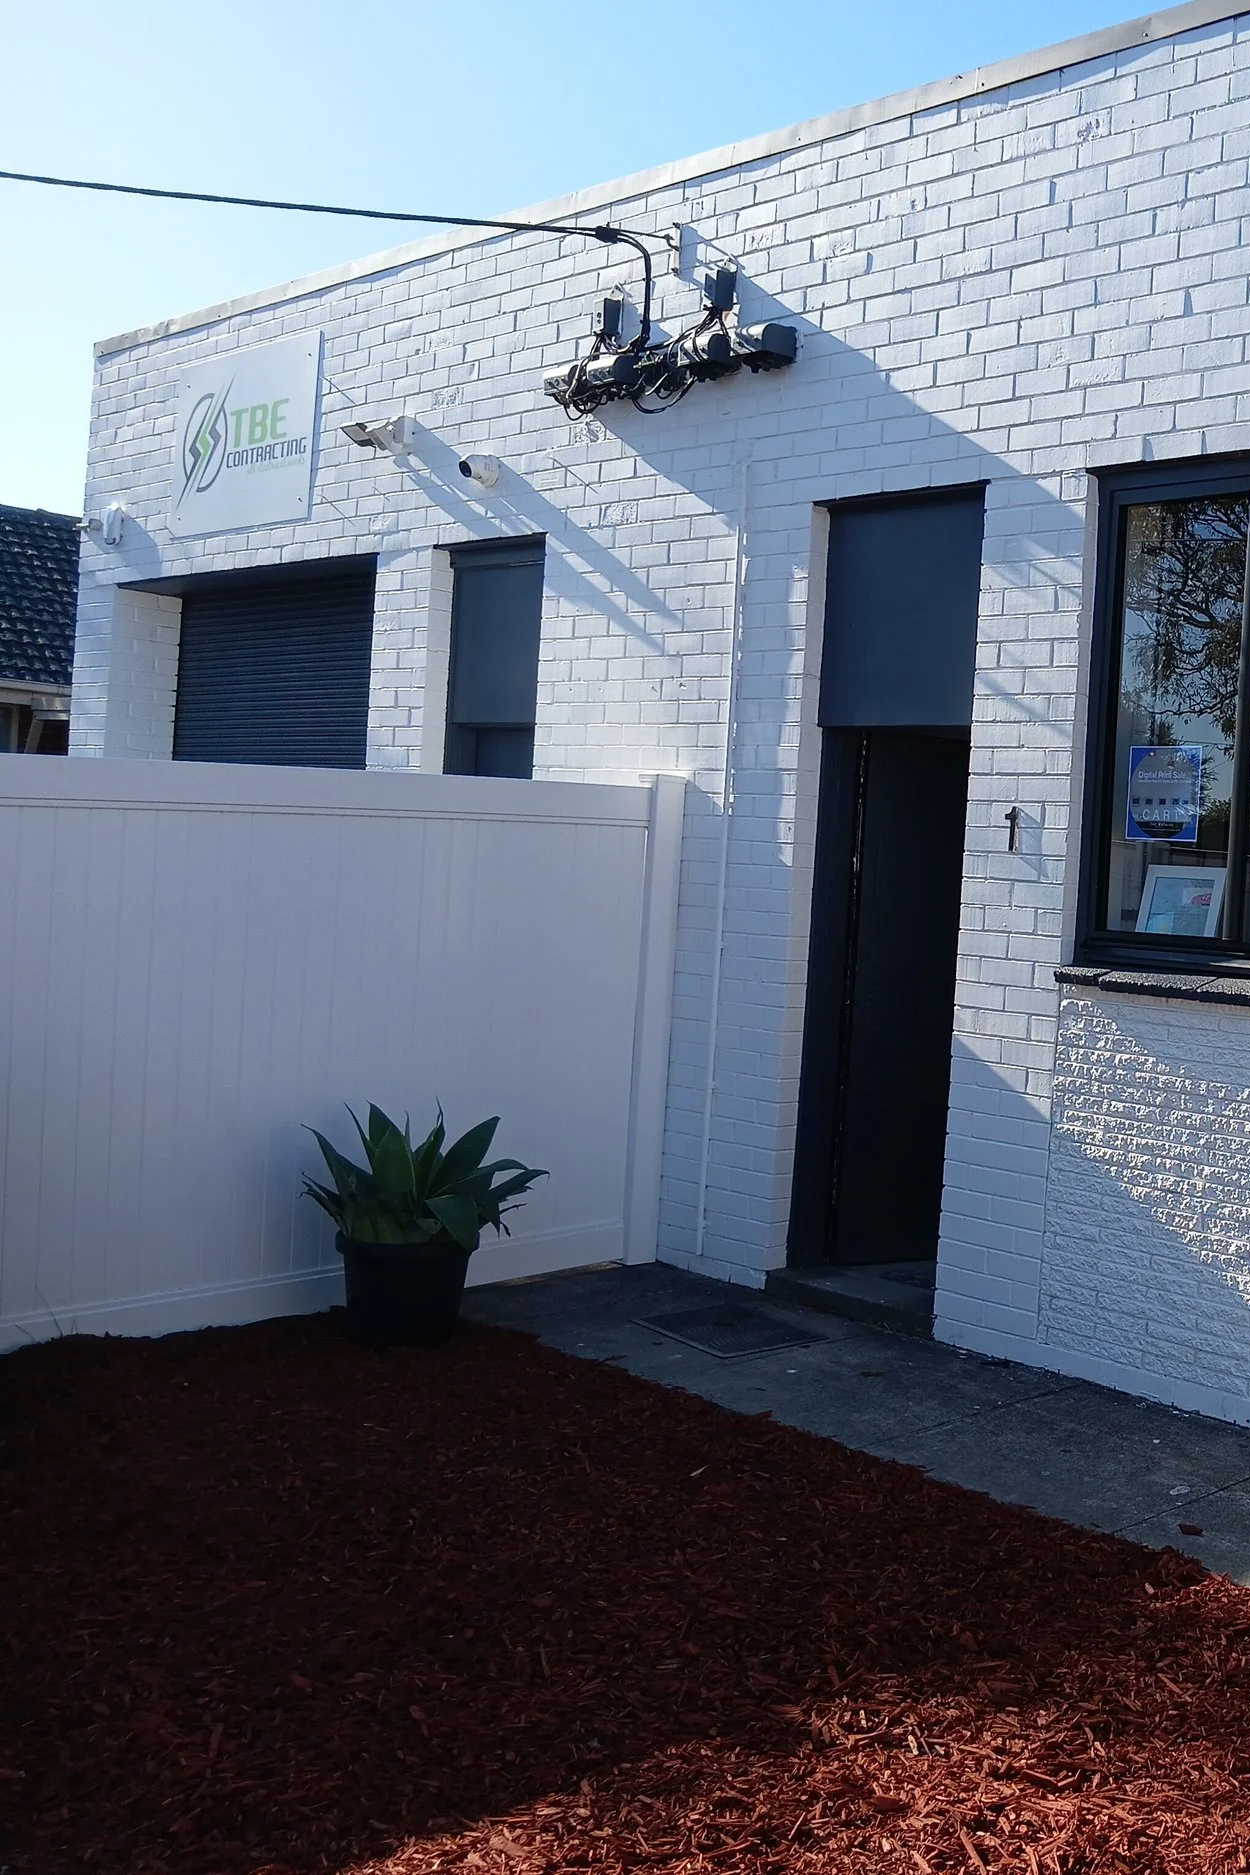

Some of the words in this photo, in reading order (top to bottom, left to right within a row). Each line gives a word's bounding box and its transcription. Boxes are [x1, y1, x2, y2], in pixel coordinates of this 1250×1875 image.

[230, 398, 290, 448] TBE
[226, 437, 307, 468] CONTRACTING
[1138, 770, 1157, 779] Digital
[1158, 770, 1172, 779] Print
[1173, 770, 1187, 779] Sale
[1004, 806, 1018, 853] 1
